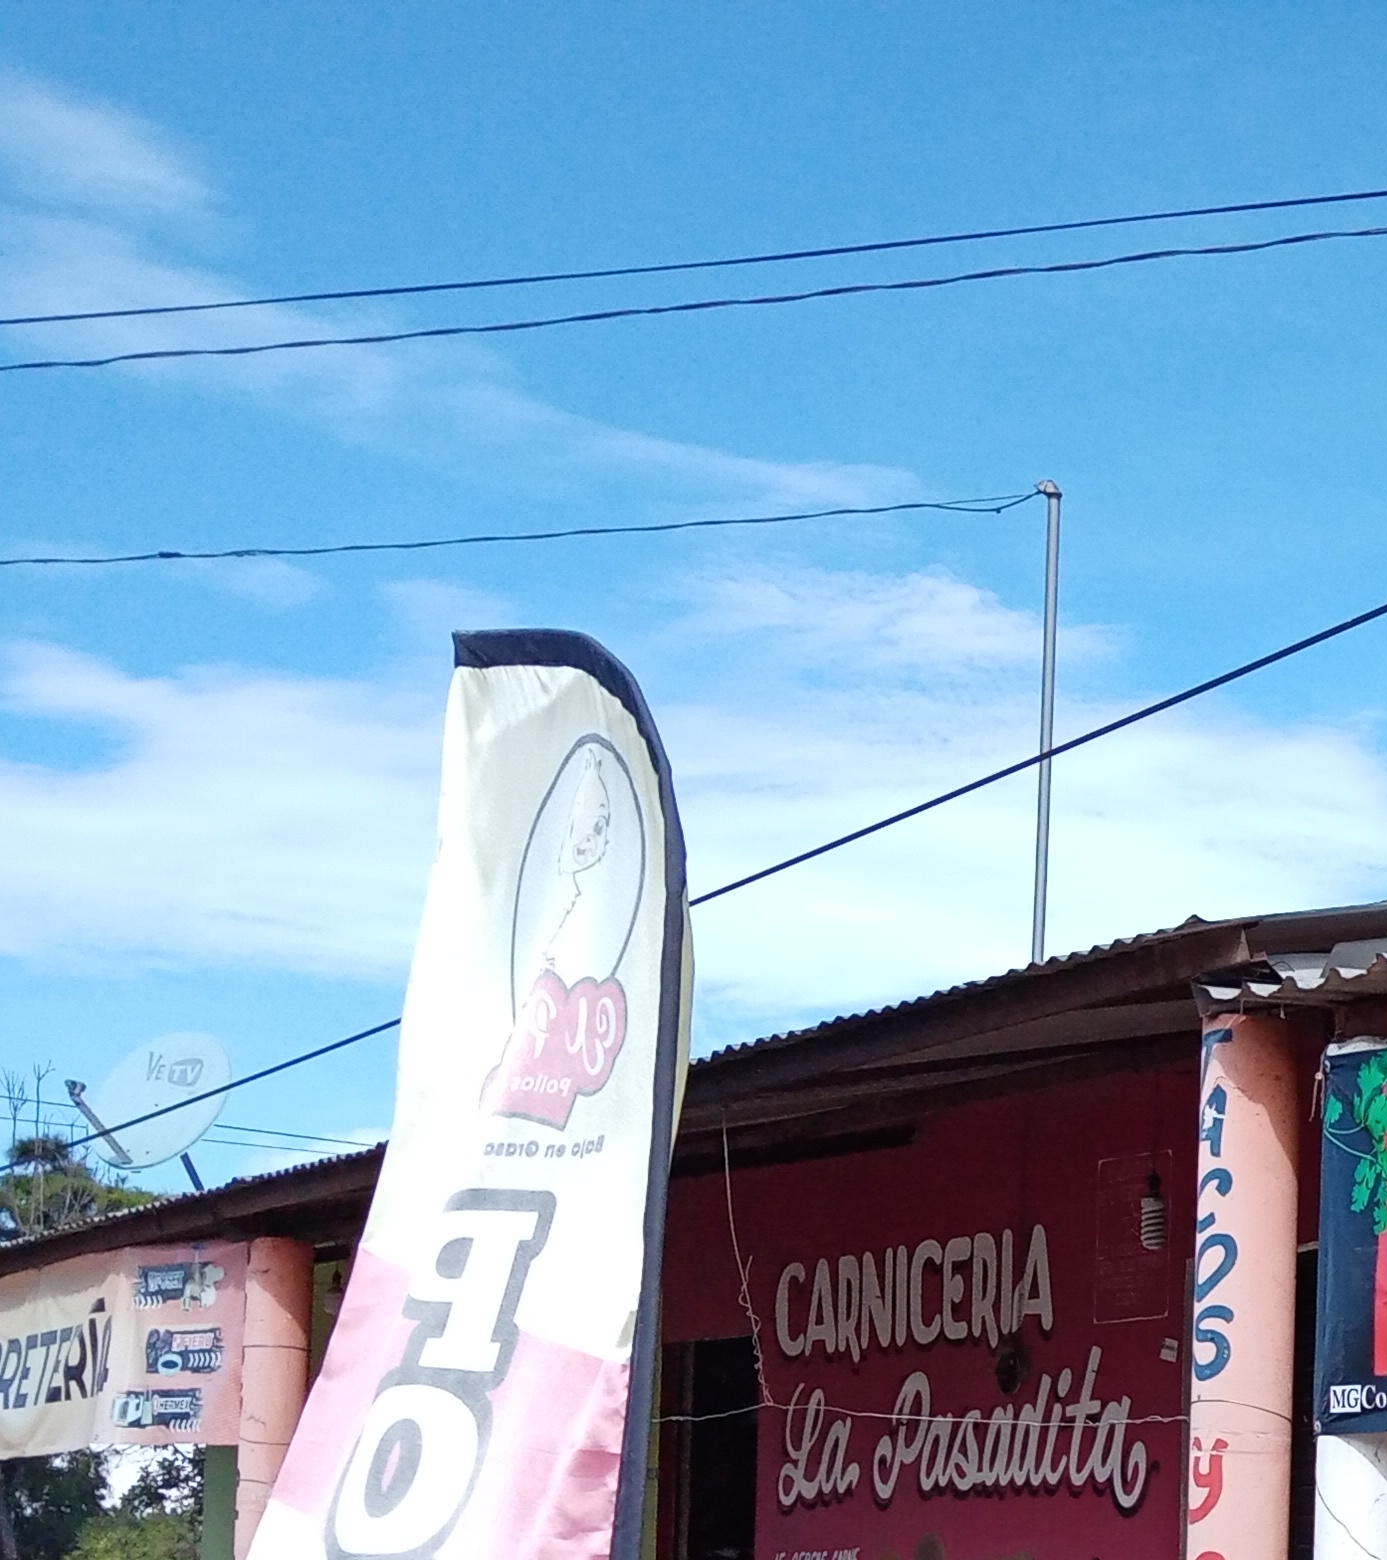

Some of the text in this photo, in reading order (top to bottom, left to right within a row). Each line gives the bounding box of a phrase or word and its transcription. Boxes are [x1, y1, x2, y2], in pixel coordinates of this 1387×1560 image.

[0, 1297, 112, 1411] RETERÍA
[775, 1224, 1053, 1363] CARNICERIA
[778, 1346, 1147, 1508] La Pasadita
